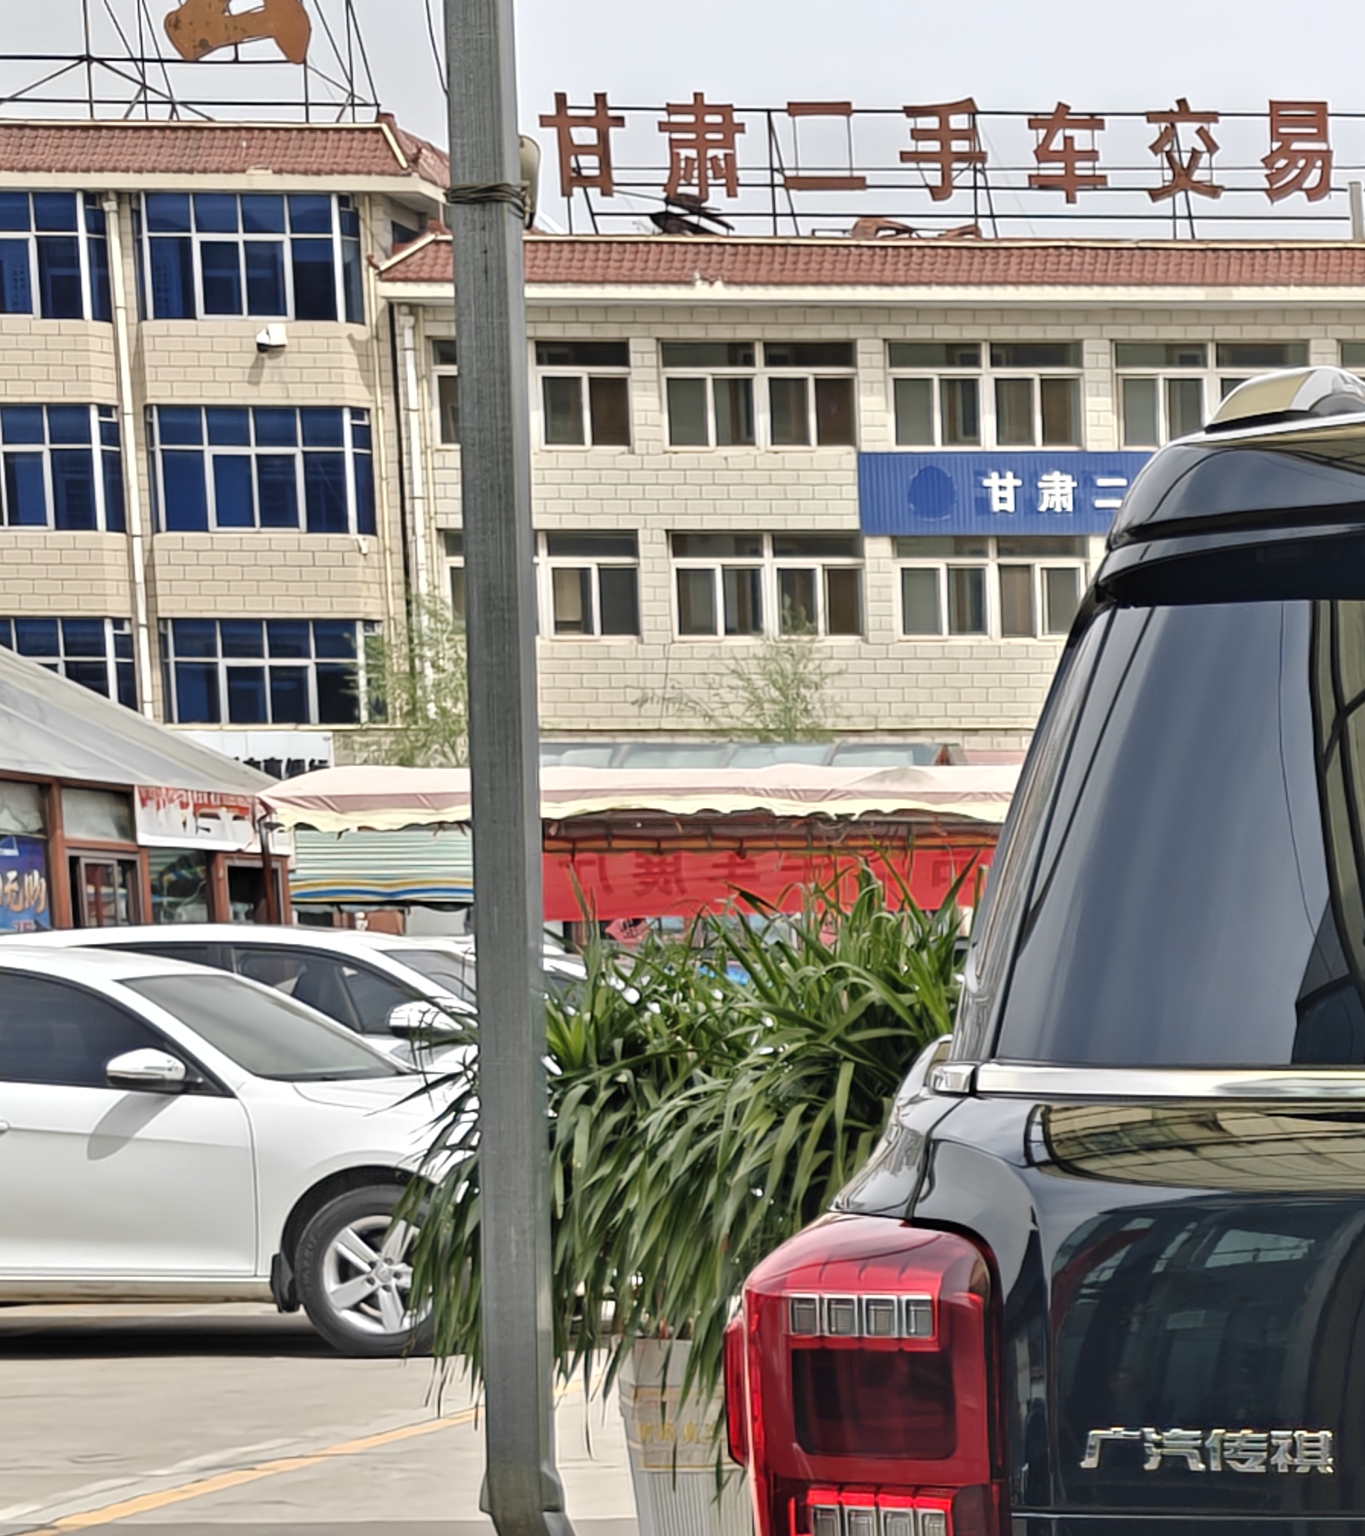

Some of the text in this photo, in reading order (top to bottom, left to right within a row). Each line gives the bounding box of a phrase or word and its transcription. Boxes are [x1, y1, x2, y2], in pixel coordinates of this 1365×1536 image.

[981, 470, 1128, 513] 甘肃二
[1079, 1426, 1335, 1474] 广汽传祺
